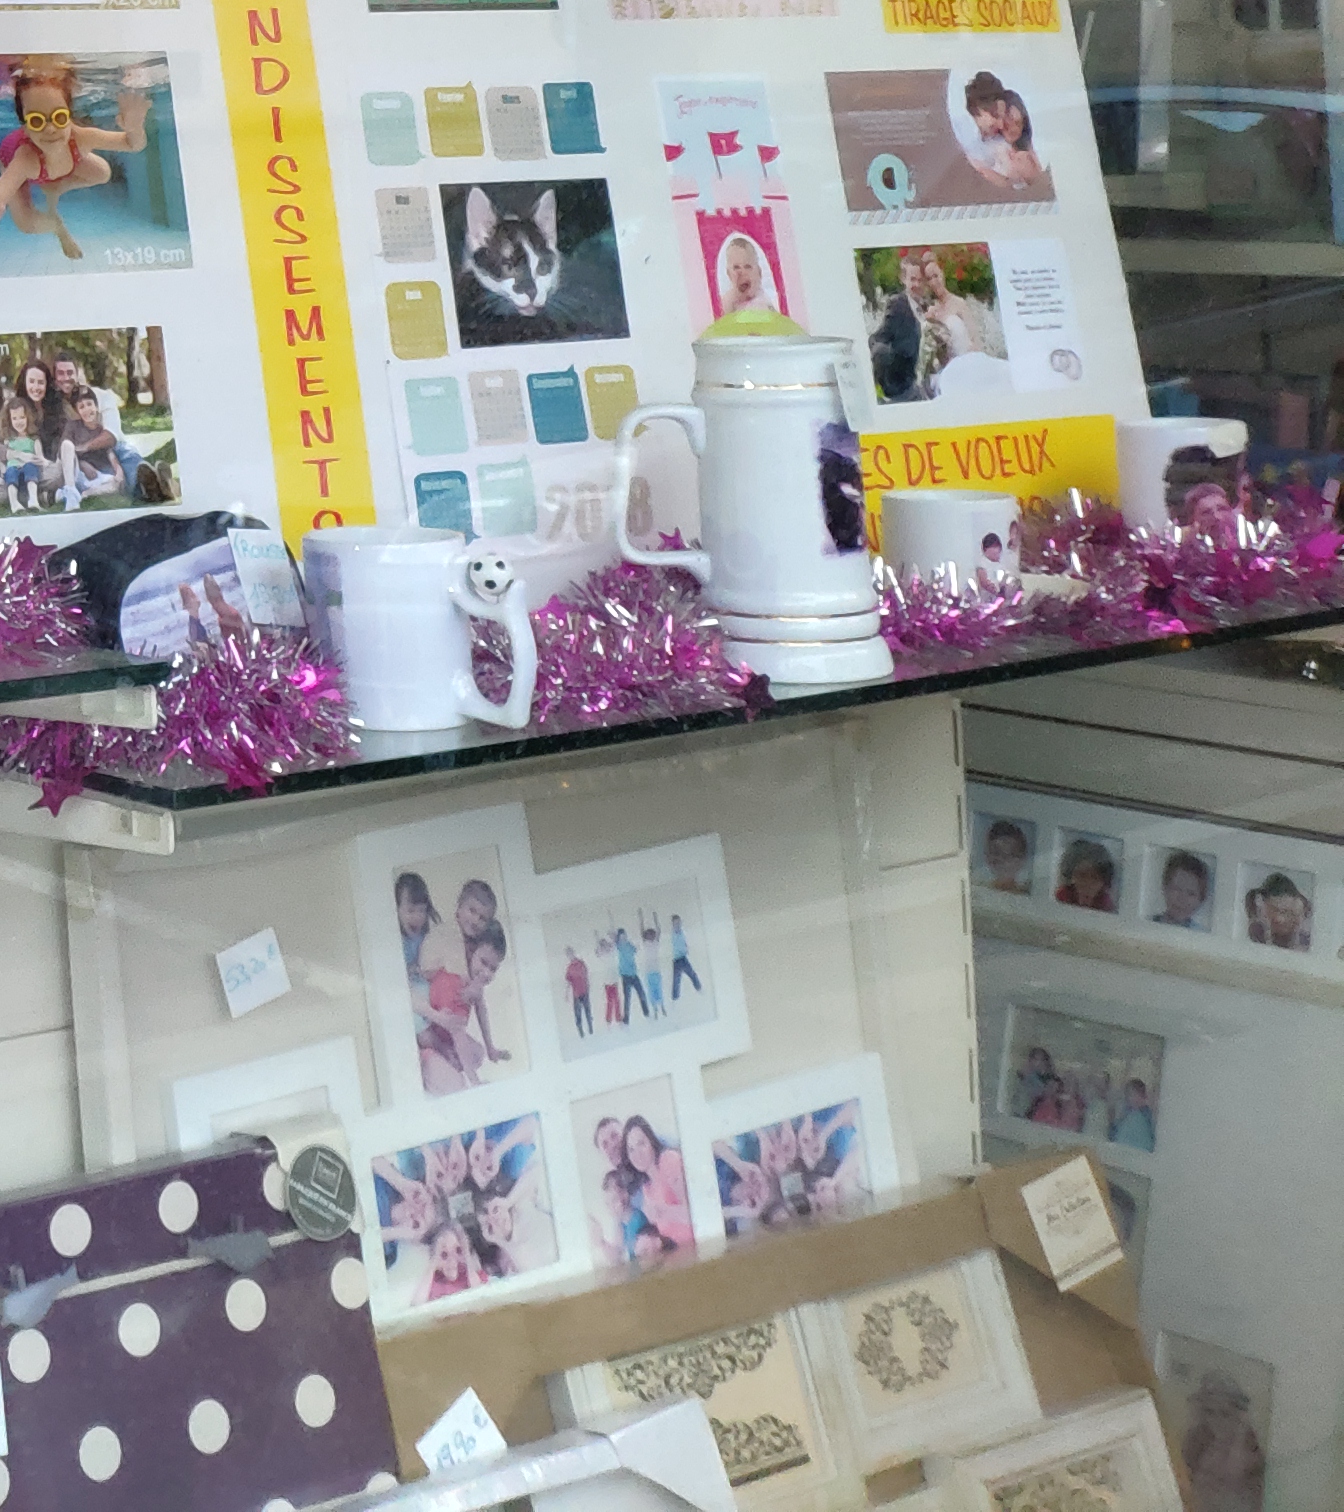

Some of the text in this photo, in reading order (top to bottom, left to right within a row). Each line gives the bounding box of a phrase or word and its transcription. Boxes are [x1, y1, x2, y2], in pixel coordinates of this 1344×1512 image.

[160, 249, 186, 264] cm
[902, 440, 947, 487] DE
[950, 428, 1056, 481] VOEUX
